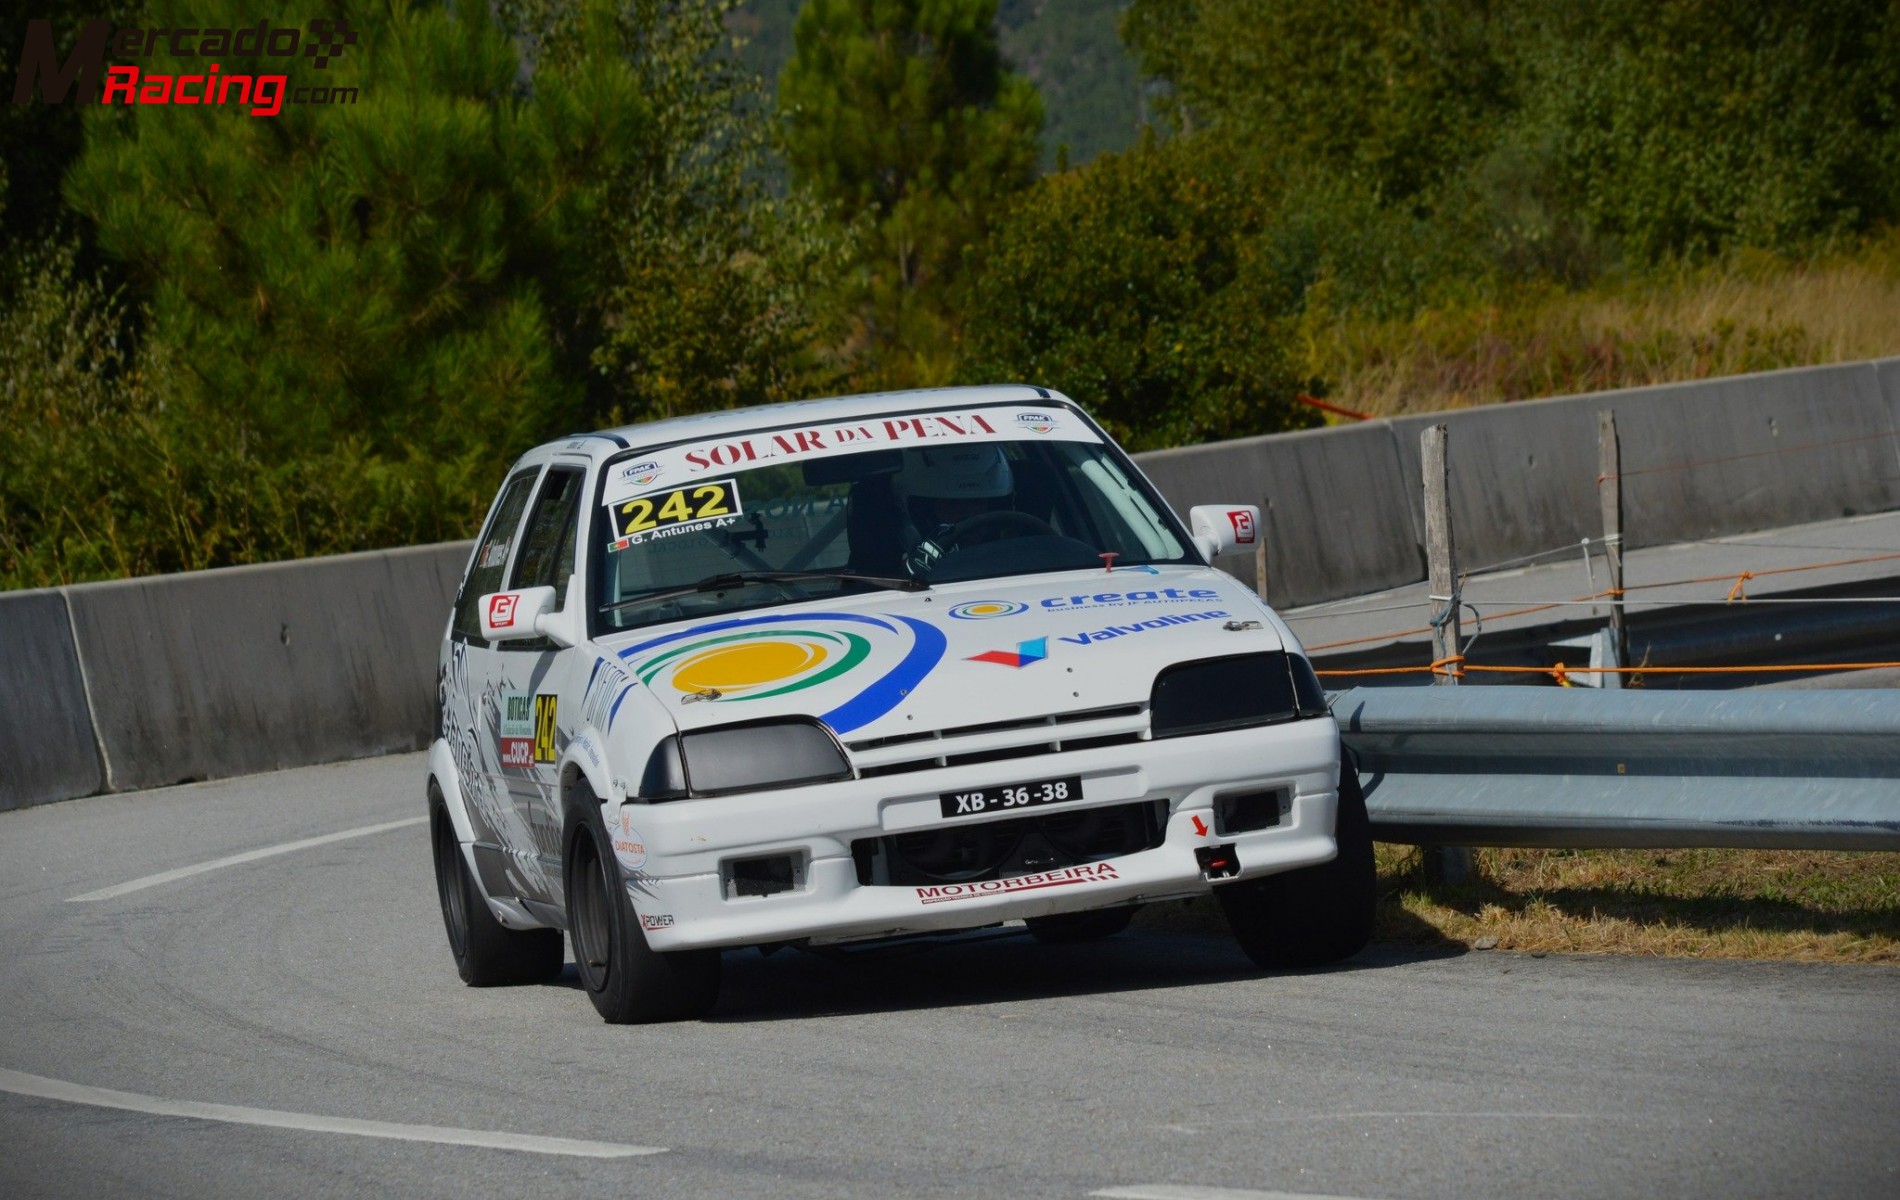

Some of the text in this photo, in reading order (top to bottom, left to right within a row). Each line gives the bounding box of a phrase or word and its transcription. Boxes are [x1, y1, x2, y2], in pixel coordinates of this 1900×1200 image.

[685, 414, 998, 472] SOLAR DA PENA
[621, 484, 729, 535] 242
[631, 516, 737, 546] G. Antunes A+
[1039, 587, 1219, 610] create
[1048, 602, 1105, 613] business
[1108, 601, 1124, 609] by
[1057, 609, 1232, 646] Valvoline
[534, 695, 556, 762] 242
[956, 793, 986, 814] XB
[1003, 787, 1030, 808] 36
[916, 862, 1117, 899] MOTORBEIRA
[641, 913, 675, 928] XPOWER
